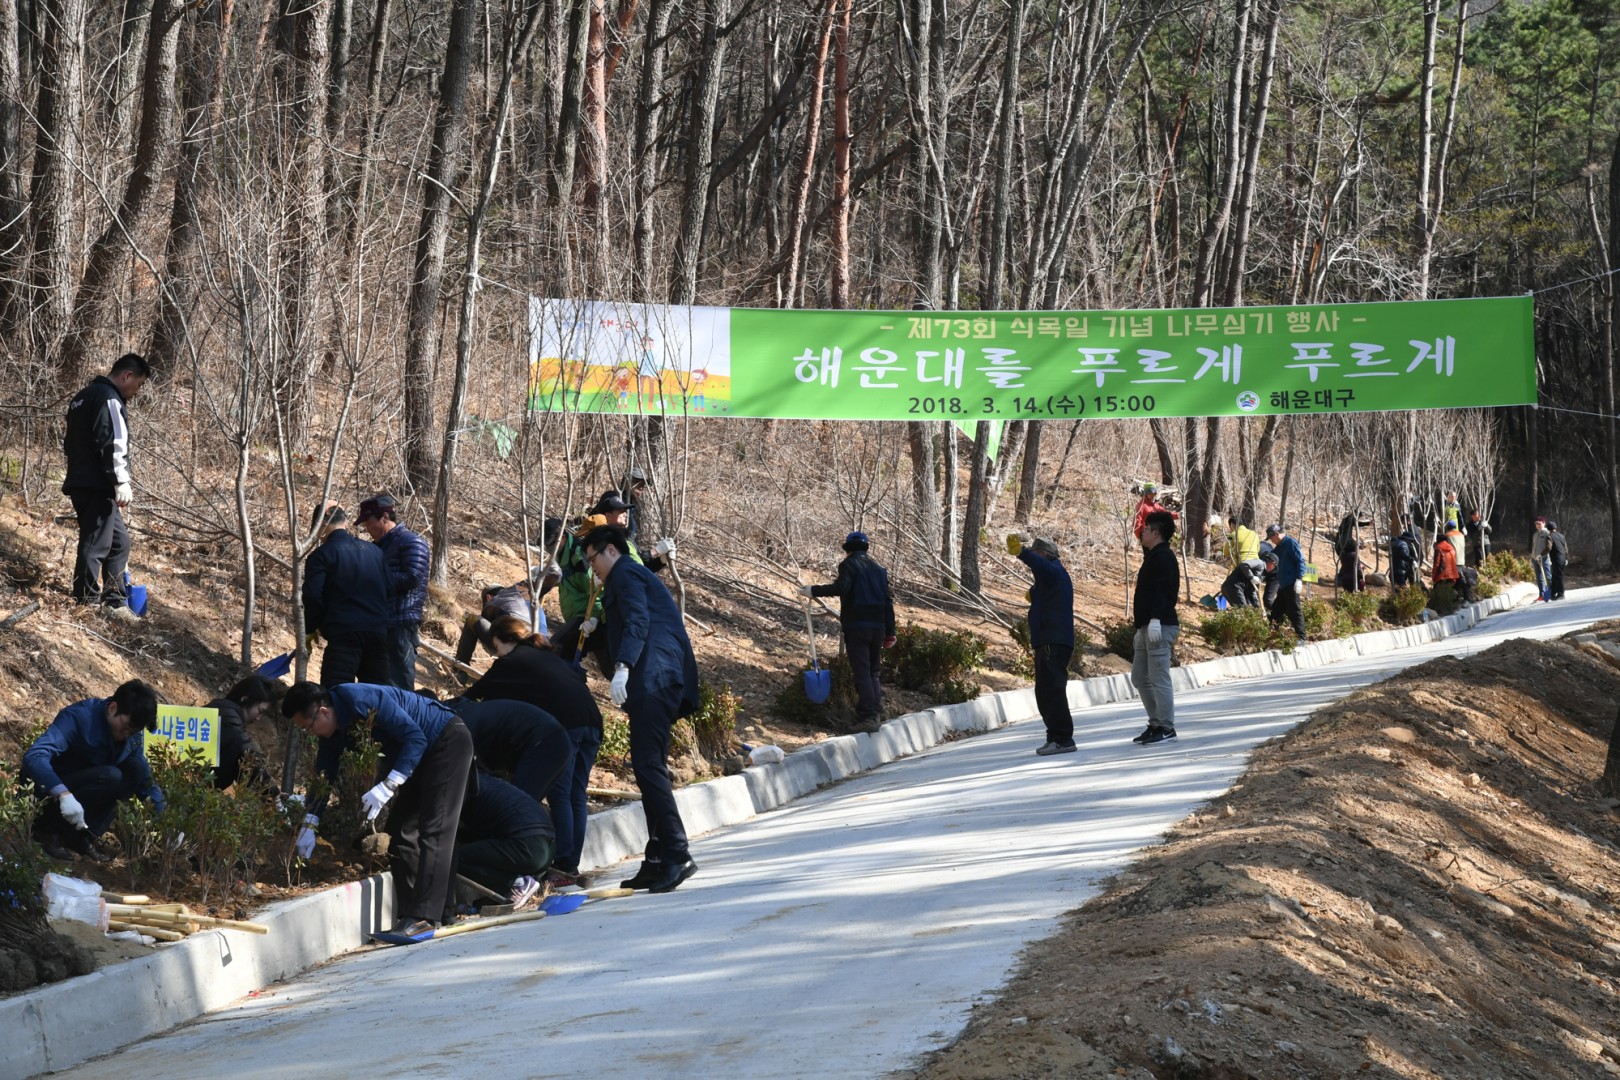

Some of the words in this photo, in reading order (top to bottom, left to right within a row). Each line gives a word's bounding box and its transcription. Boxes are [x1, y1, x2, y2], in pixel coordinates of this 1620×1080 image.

[907, 316, 996, 339] 제73회
[1010, 316, 1089, 339] 식목일
[1101, 314, 1153, 338] 기념
[1167, 312, 1273, 336] 나무심기
[1286, 310, 1340, 333] 행사
[792, 345, 1032, 389] 해운대를
[1071, 343, 1243, 388] 푸르게
[1284, 335, 1456, 382] 푸르게
[908, 397, 968, 414] 2018.
[982, 397, 1001, 414] 3.
[1012, 395, 1086, 415] 14.(수)
[1093, 395, 1156, 413] 15:00
[1269, 388, 1356, 410] 해운대구
